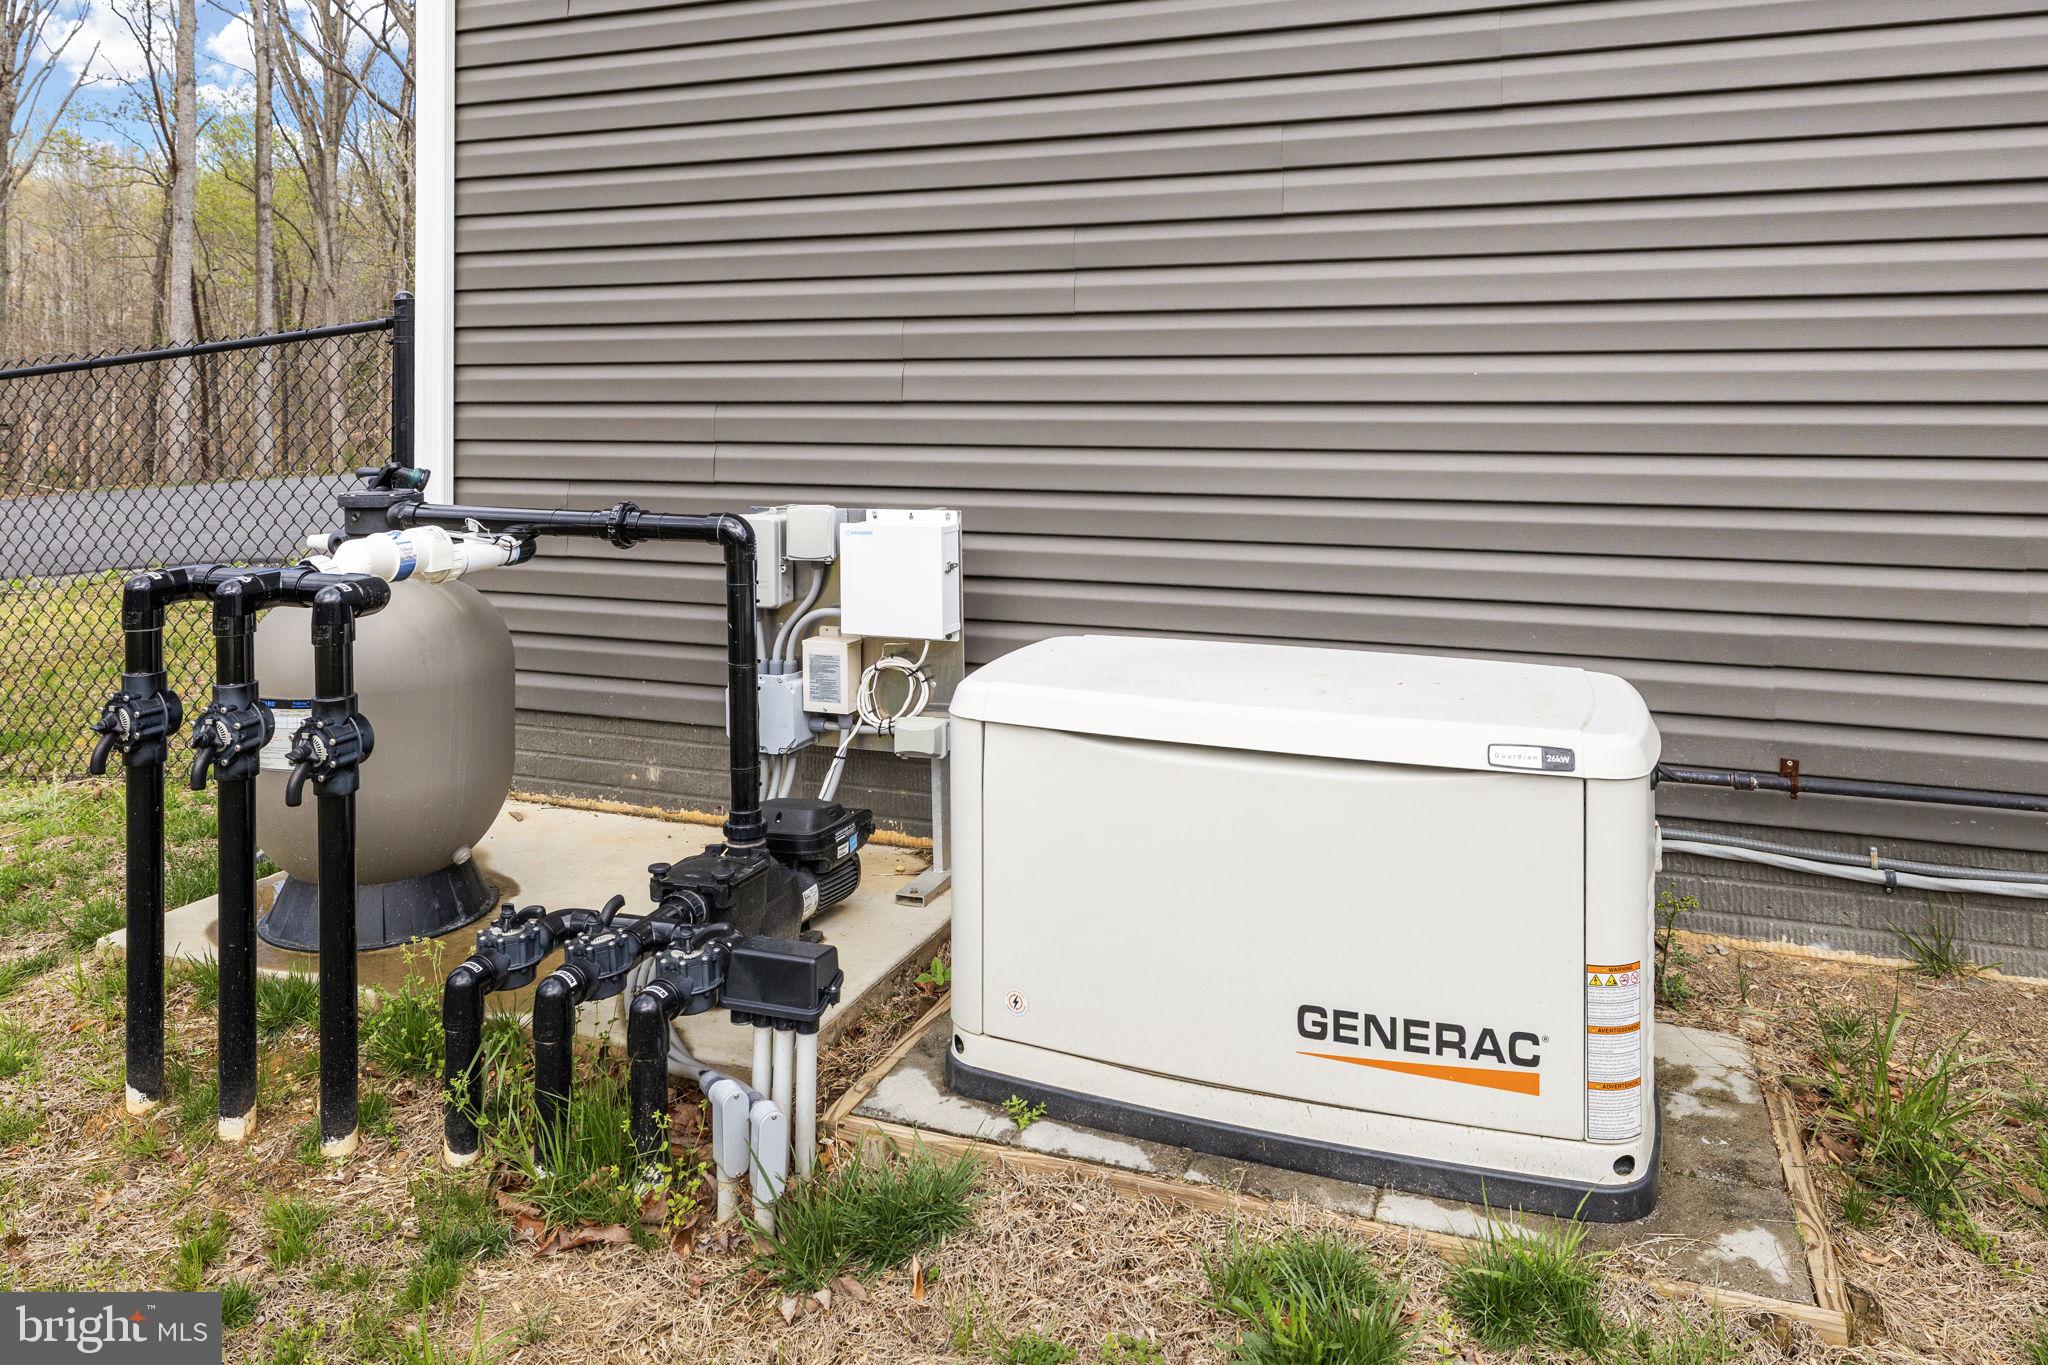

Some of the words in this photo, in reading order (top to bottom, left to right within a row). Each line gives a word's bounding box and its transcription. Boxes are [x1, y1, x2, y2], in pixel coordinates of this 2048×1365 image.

[1494, 752, 1538, 761] Guardian
[1546, 755, 1570, 764] 26kW
[1608, 965, 1633, 973] WARNING
